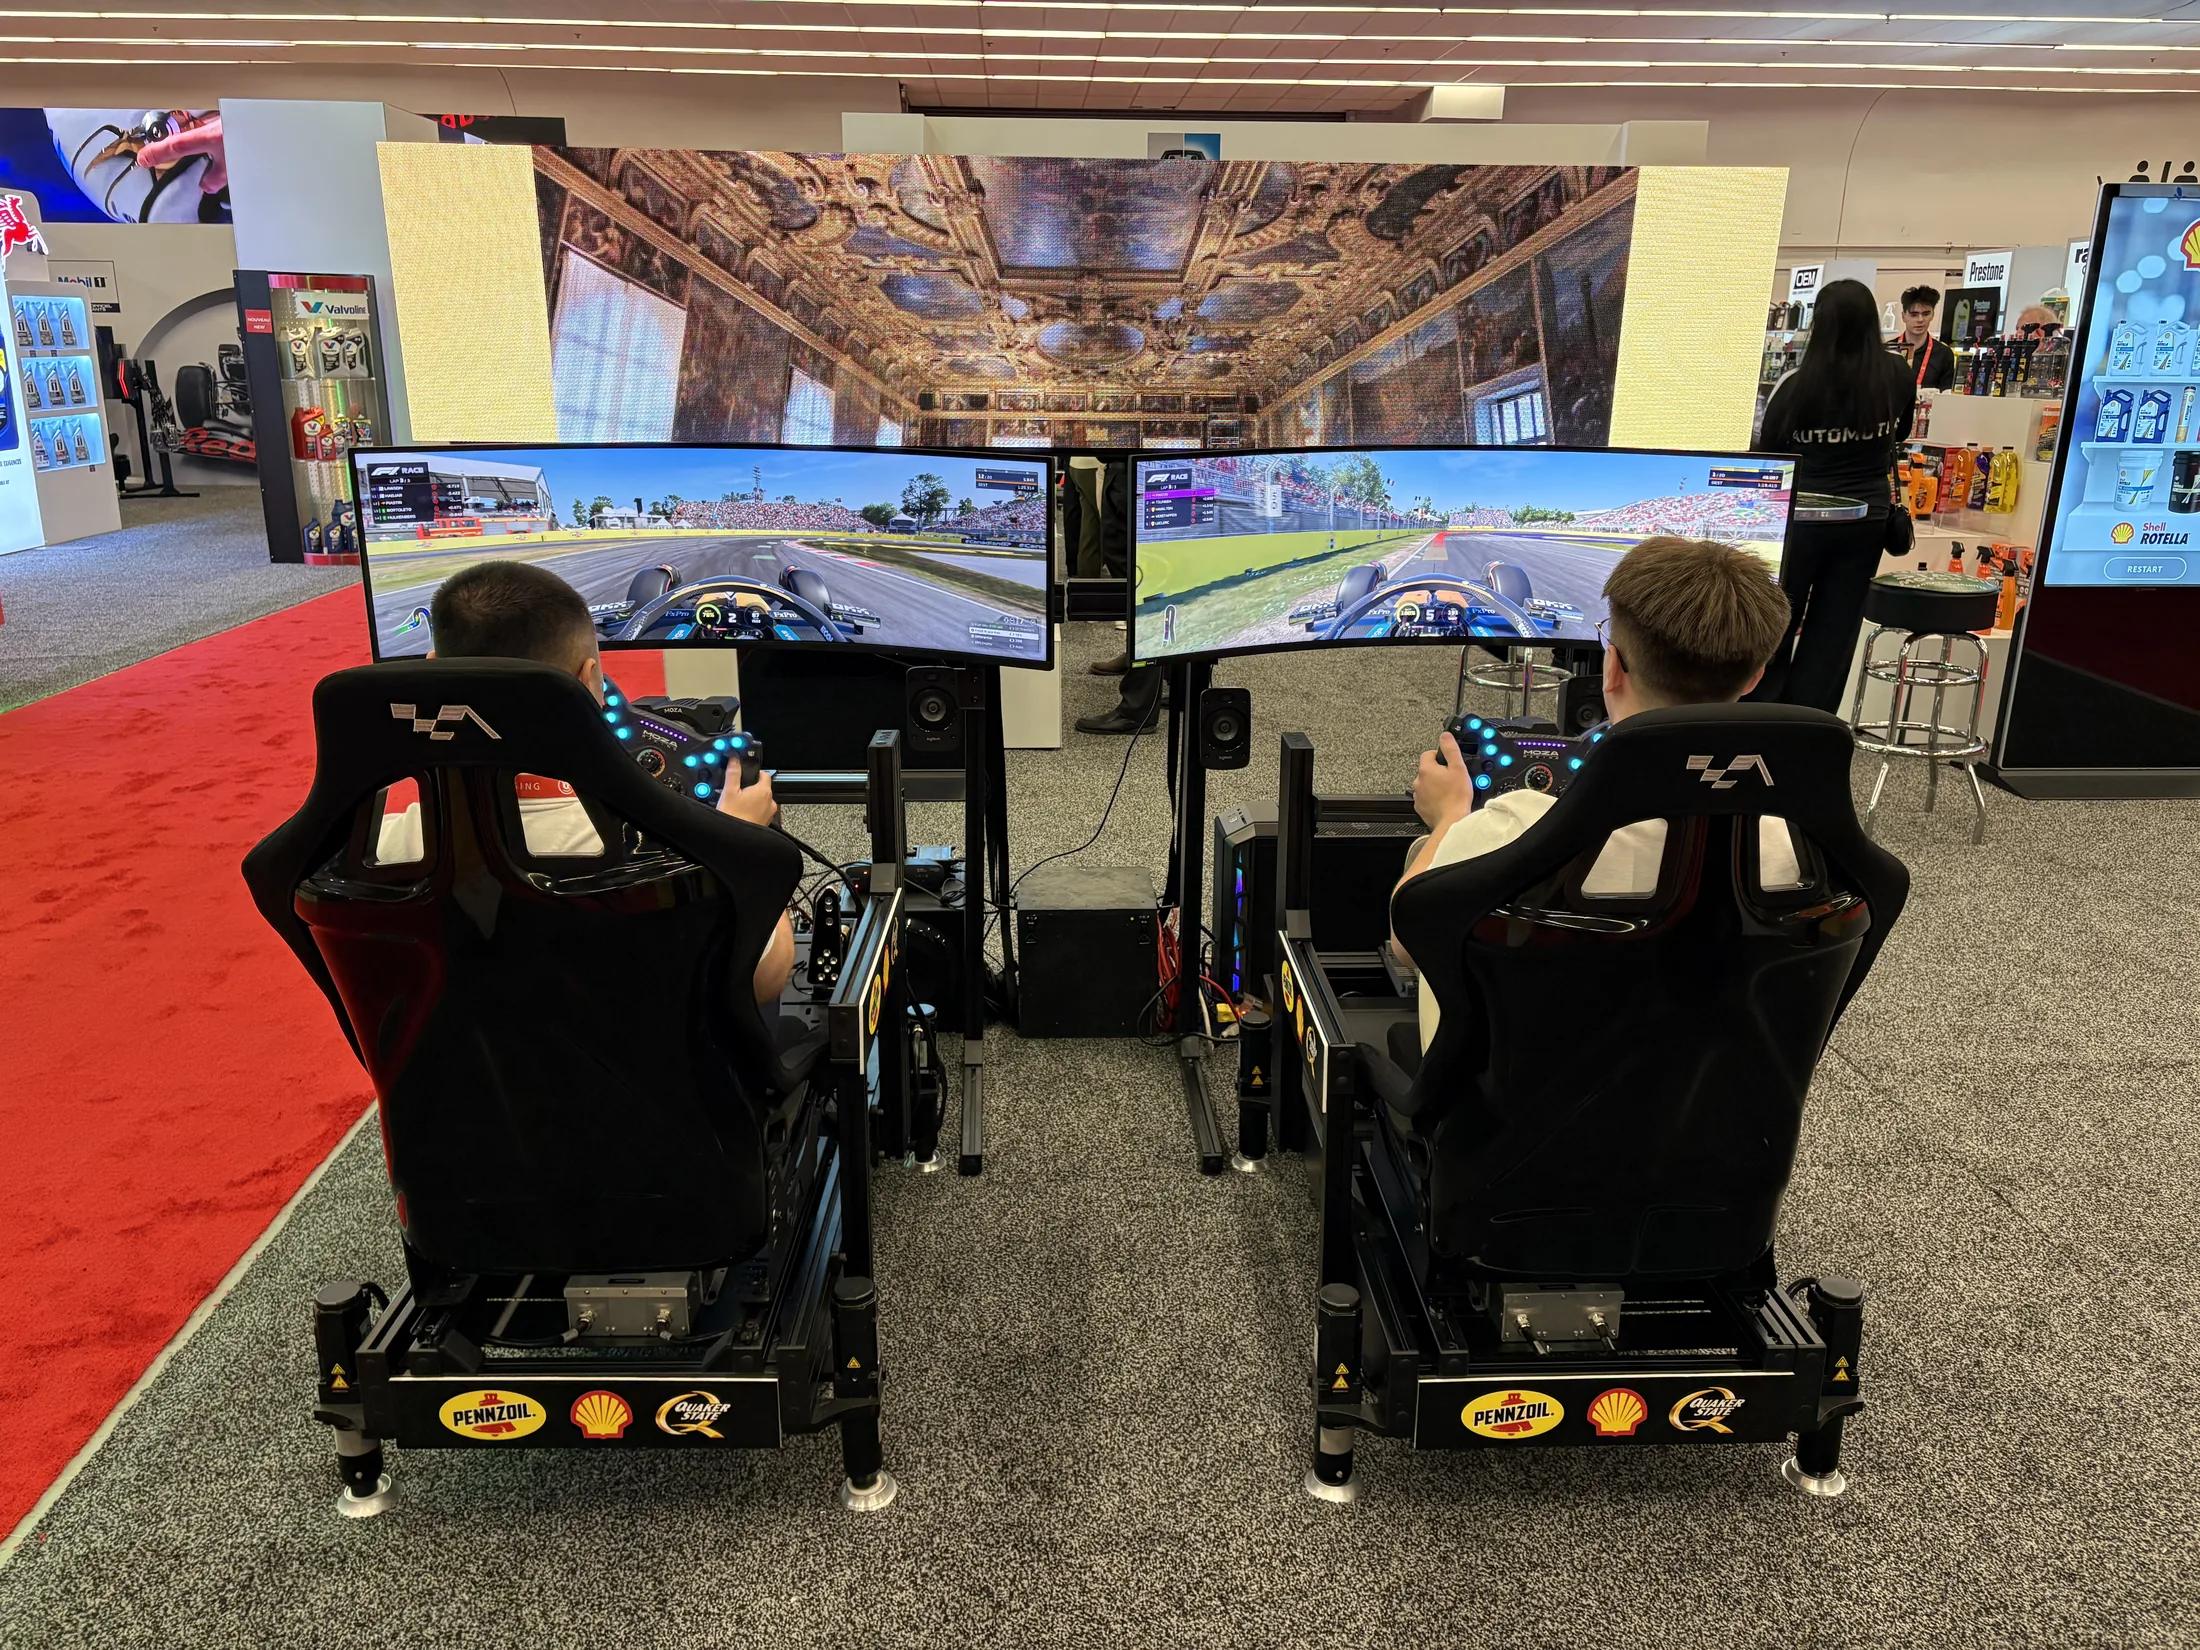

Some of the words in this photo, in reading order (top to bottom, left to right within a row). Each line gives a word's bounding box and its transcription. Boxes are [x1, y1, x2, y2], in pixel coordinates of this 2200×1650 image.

[1969, 261, 2005, 282] Prestone
[1796, 271, 1816, 287] OEM
[325, 304, 367, 315] Valvoline
[2143, 522, 2166, 531] Shell
[2140, 533, 2188, 545] ROTELLA
[2127, 565, 2163, 573] RESTART
[728, 612, 737, 623] 2
[1426, 609, 1435, 621] 5
[643, 729, 678, 749] MOZA
[675, 1401, 731, 1412] QUAKER
[1690, 1397, 1746, 1408] QUAKER
[681, 1412, 721, 1420] STATE
[1694, 1407, 1735, 1416] STATE
